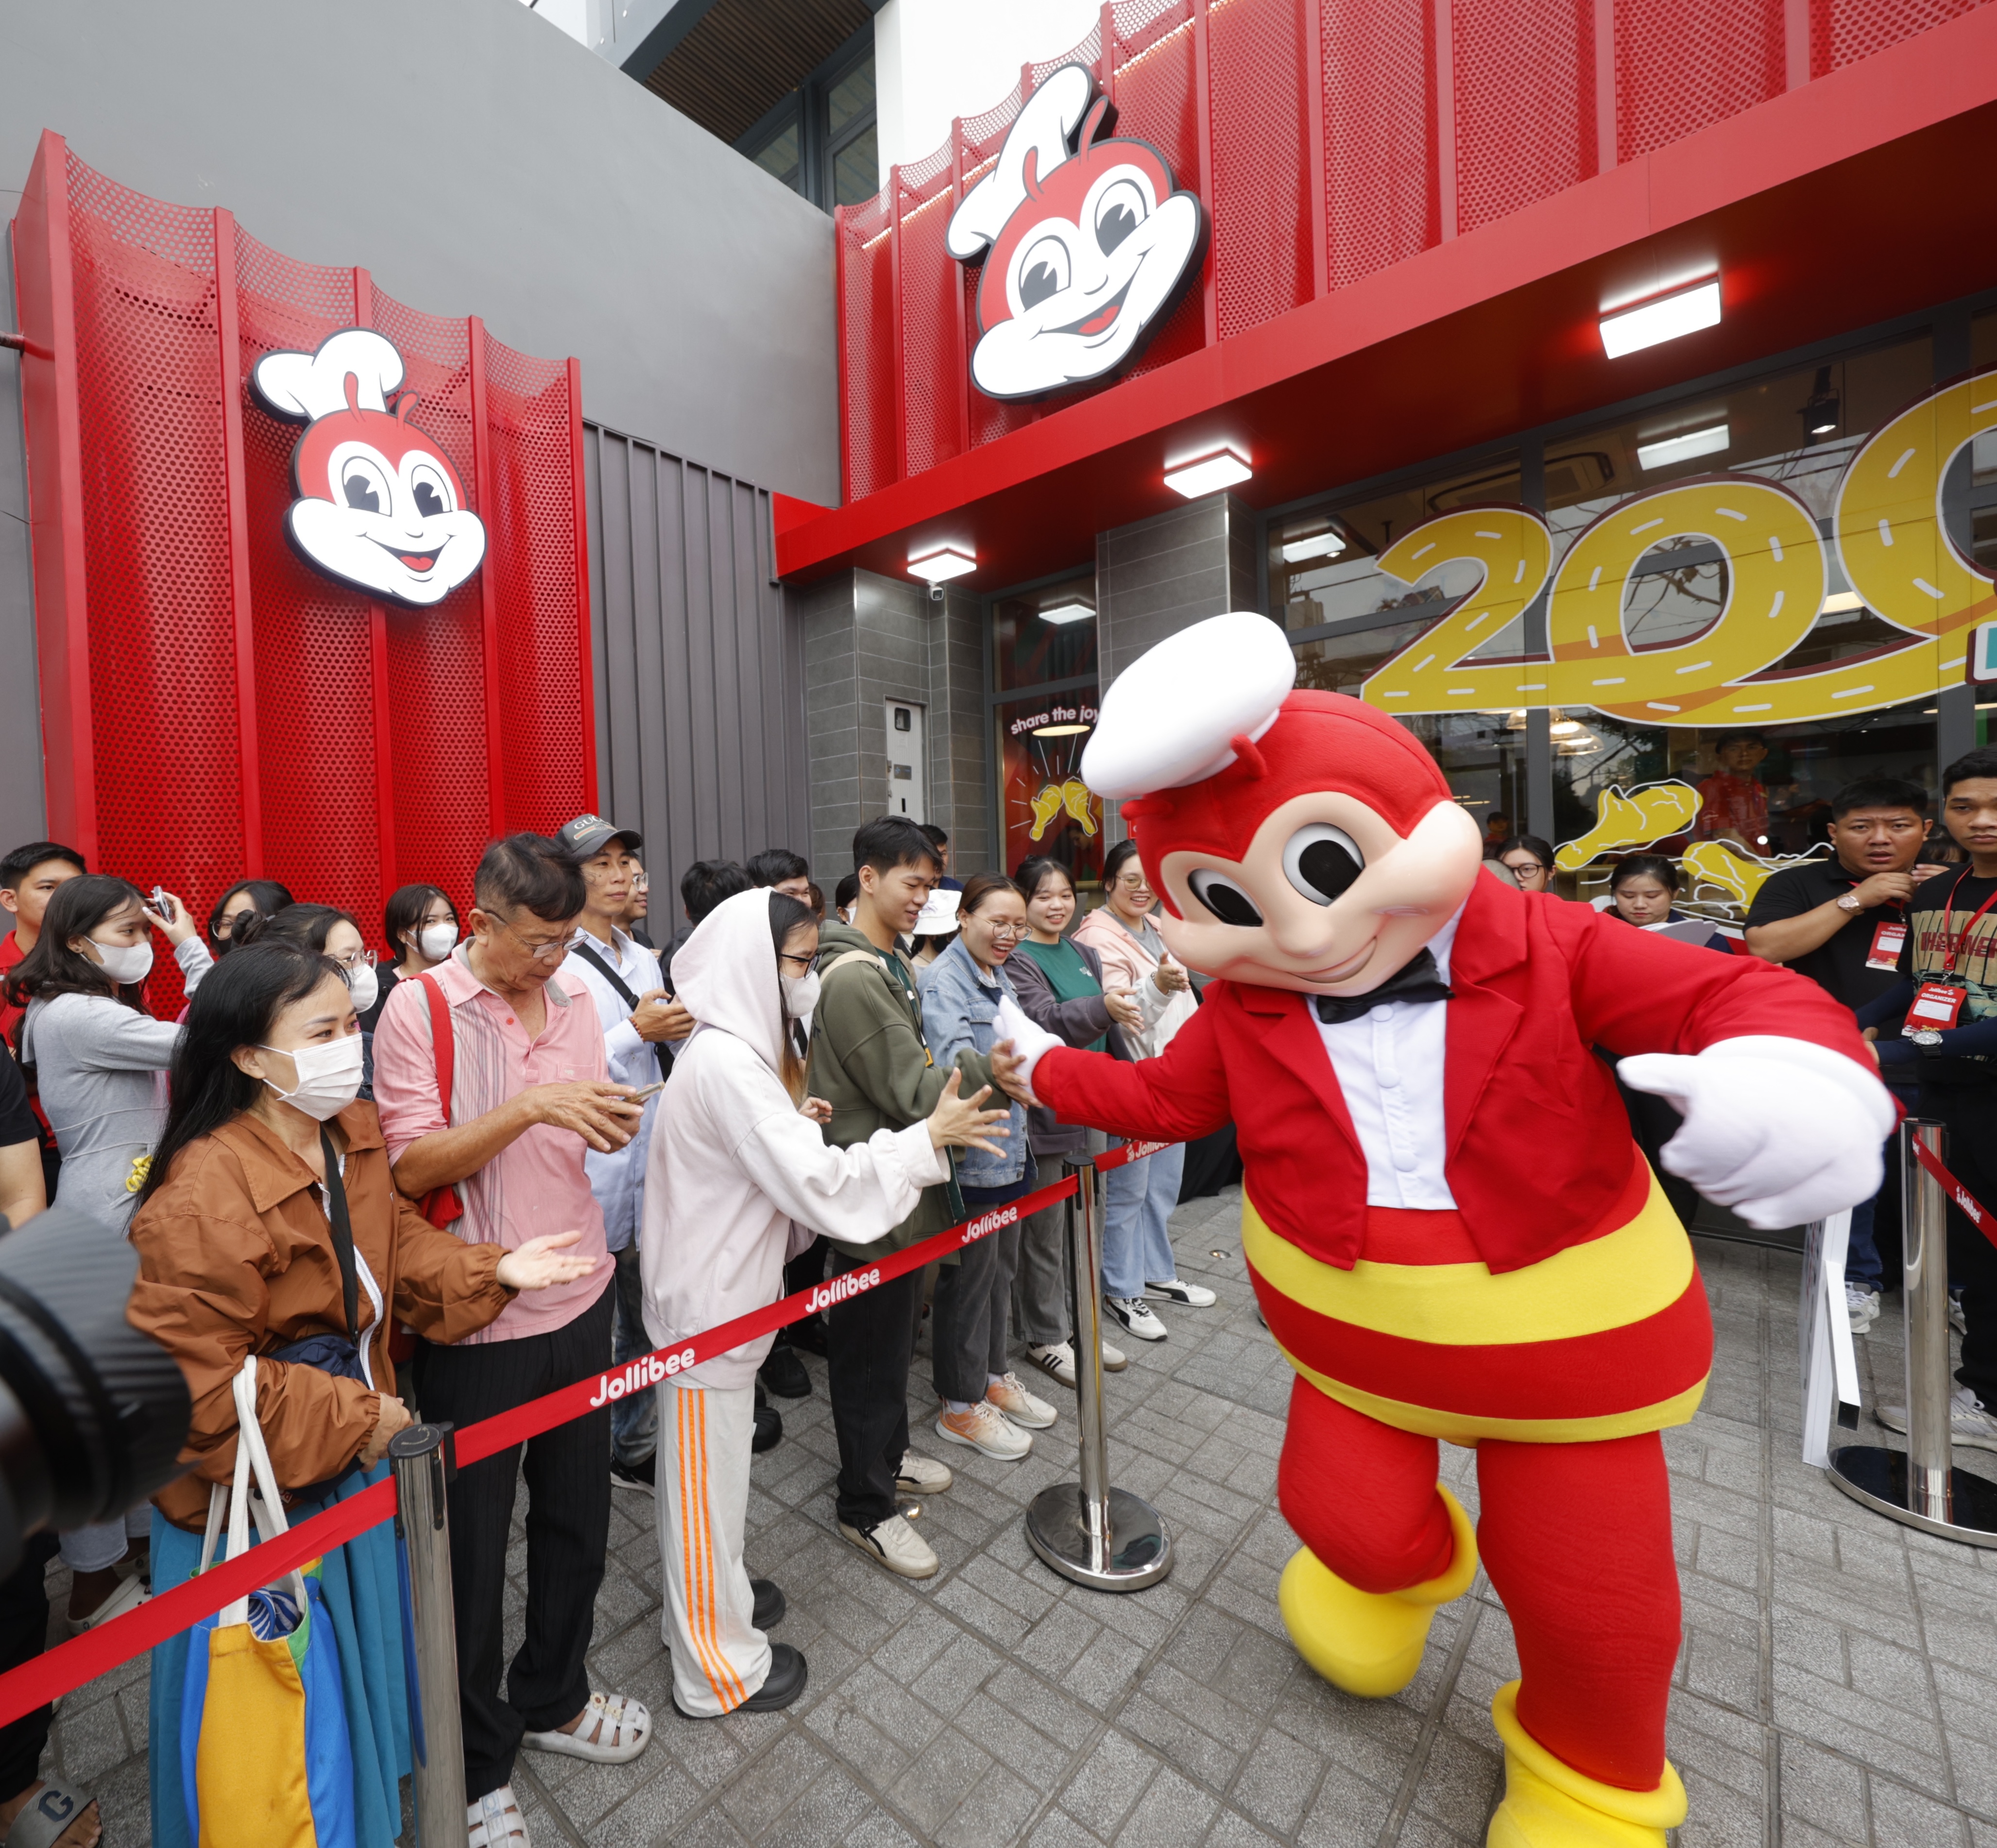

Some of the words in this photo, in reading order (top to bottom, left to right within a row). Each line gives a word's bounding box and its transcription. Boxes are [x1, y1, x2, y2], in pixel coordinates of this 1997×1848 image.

[1010, 712, 1049, 735] share
[1051, 706, 1076, 722] the
[1079, 705, 1099, 724] joy
[574, 815, 612, 830] GUC
[1921, 993, 1957, 1003] ORGANIZER
[1135, 1141, 1170, 1158] Jolli
[961, 1206, 1018, 1243] Jollibee
[805, 1268, 880, 1313] Jollibee
[590, 1348, 695, 1407] Jollibee
